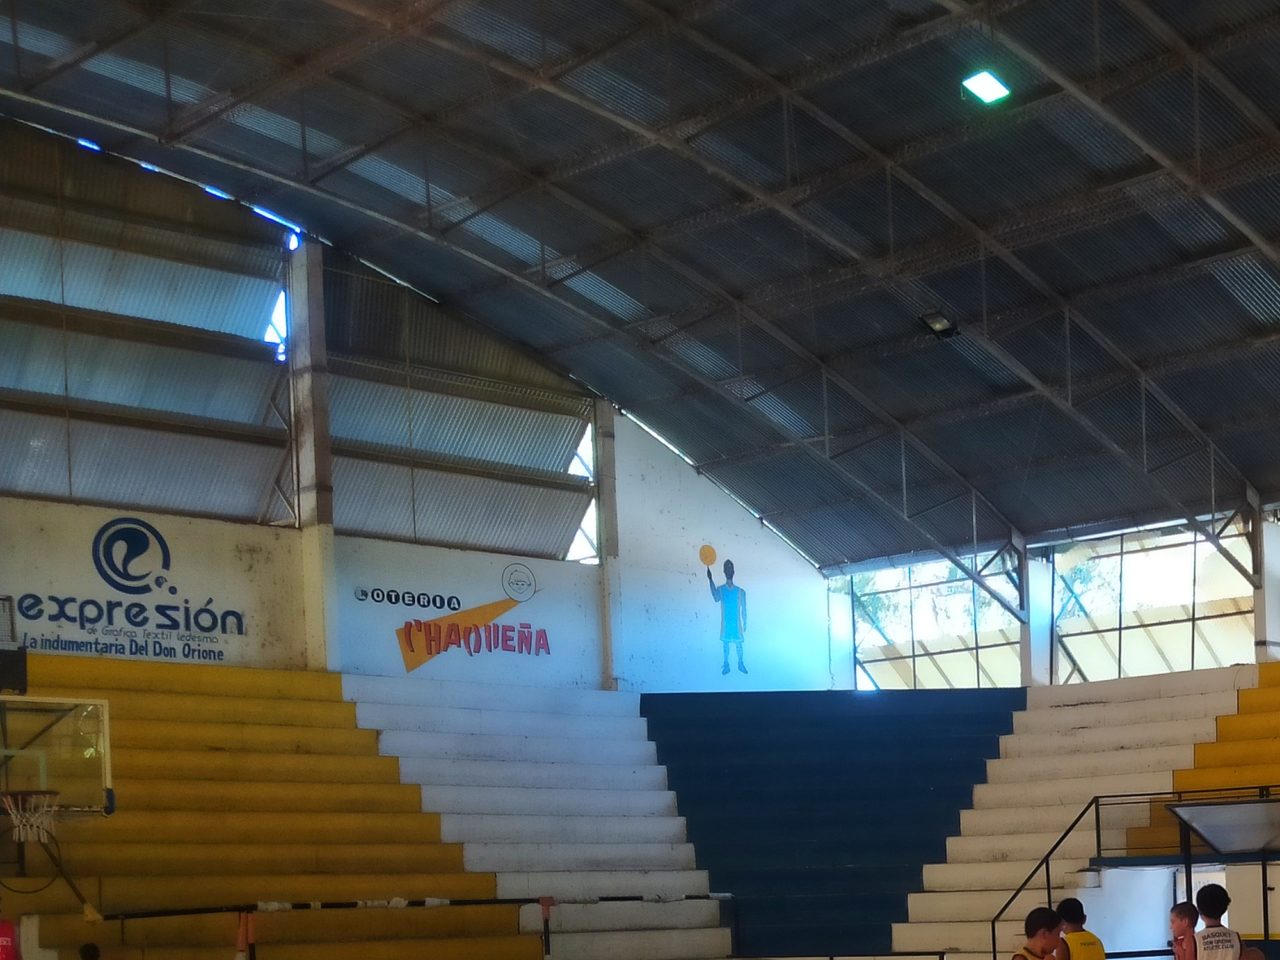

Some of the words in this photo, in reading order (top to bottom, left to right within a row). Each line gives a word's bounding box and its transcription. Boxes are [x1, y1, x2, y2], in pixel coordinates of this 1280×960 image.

[355, 588, 460, 611] LOTERIA
[17, 593, 244, 636] expresión
[23, 632, 37, 650] La
[40, 634, 125, 655] indumentaria
[129, 639, 148, 657] Del
[153, 642, 176, 659] Don
[182, 642, 224, 661] Orione
[404, 619, 550, 656] CHAQUEÑA
[1201, 932, 1231, 941] BASQUET
